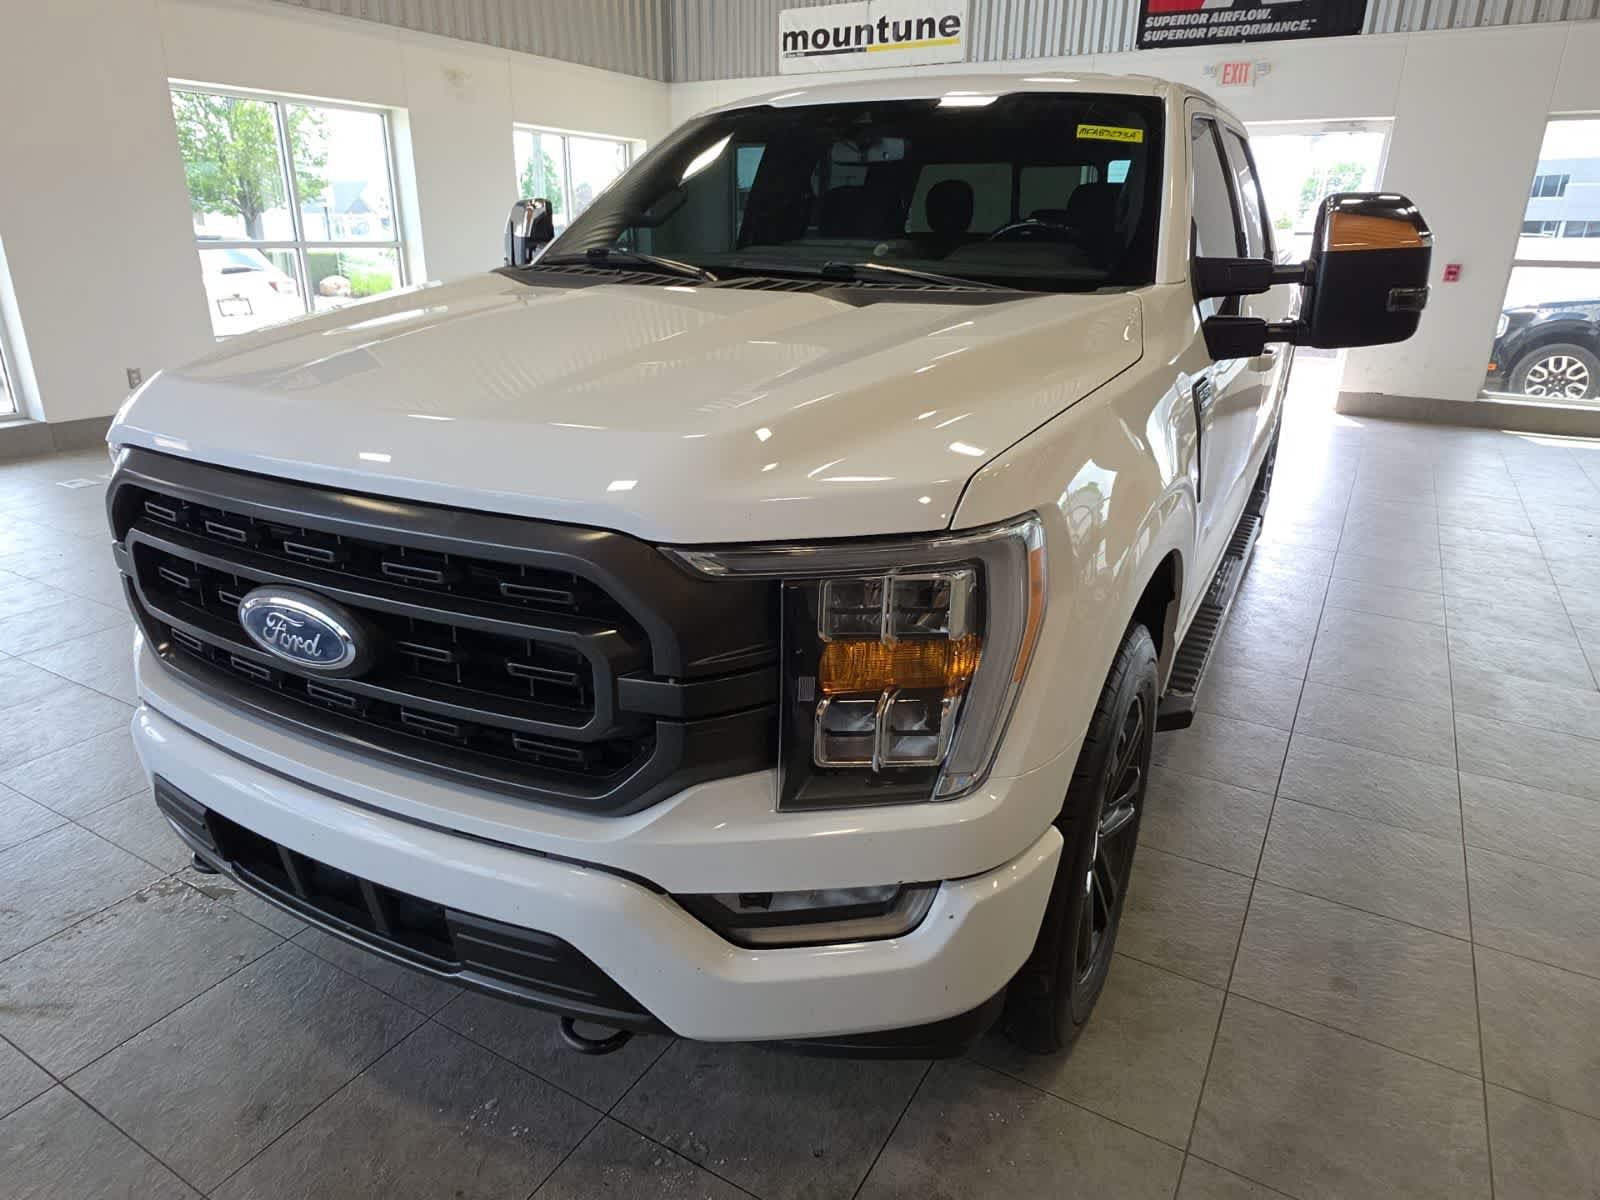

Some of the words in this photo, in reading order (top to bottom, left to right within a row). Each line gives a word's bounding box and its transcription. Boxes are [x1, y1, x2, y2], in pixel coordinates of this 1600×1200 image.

[1145, 12, 1207, 28] SUPERIOR
[1209, 8, 1272, 23] AIRFLOW.
[782, 14, 961, 52] mountune
[1143, 24, 1207, 42] SUPERIOR
[1222, 62, 1251, 85] EXIT
[262, 612, 322, 657] Ford
